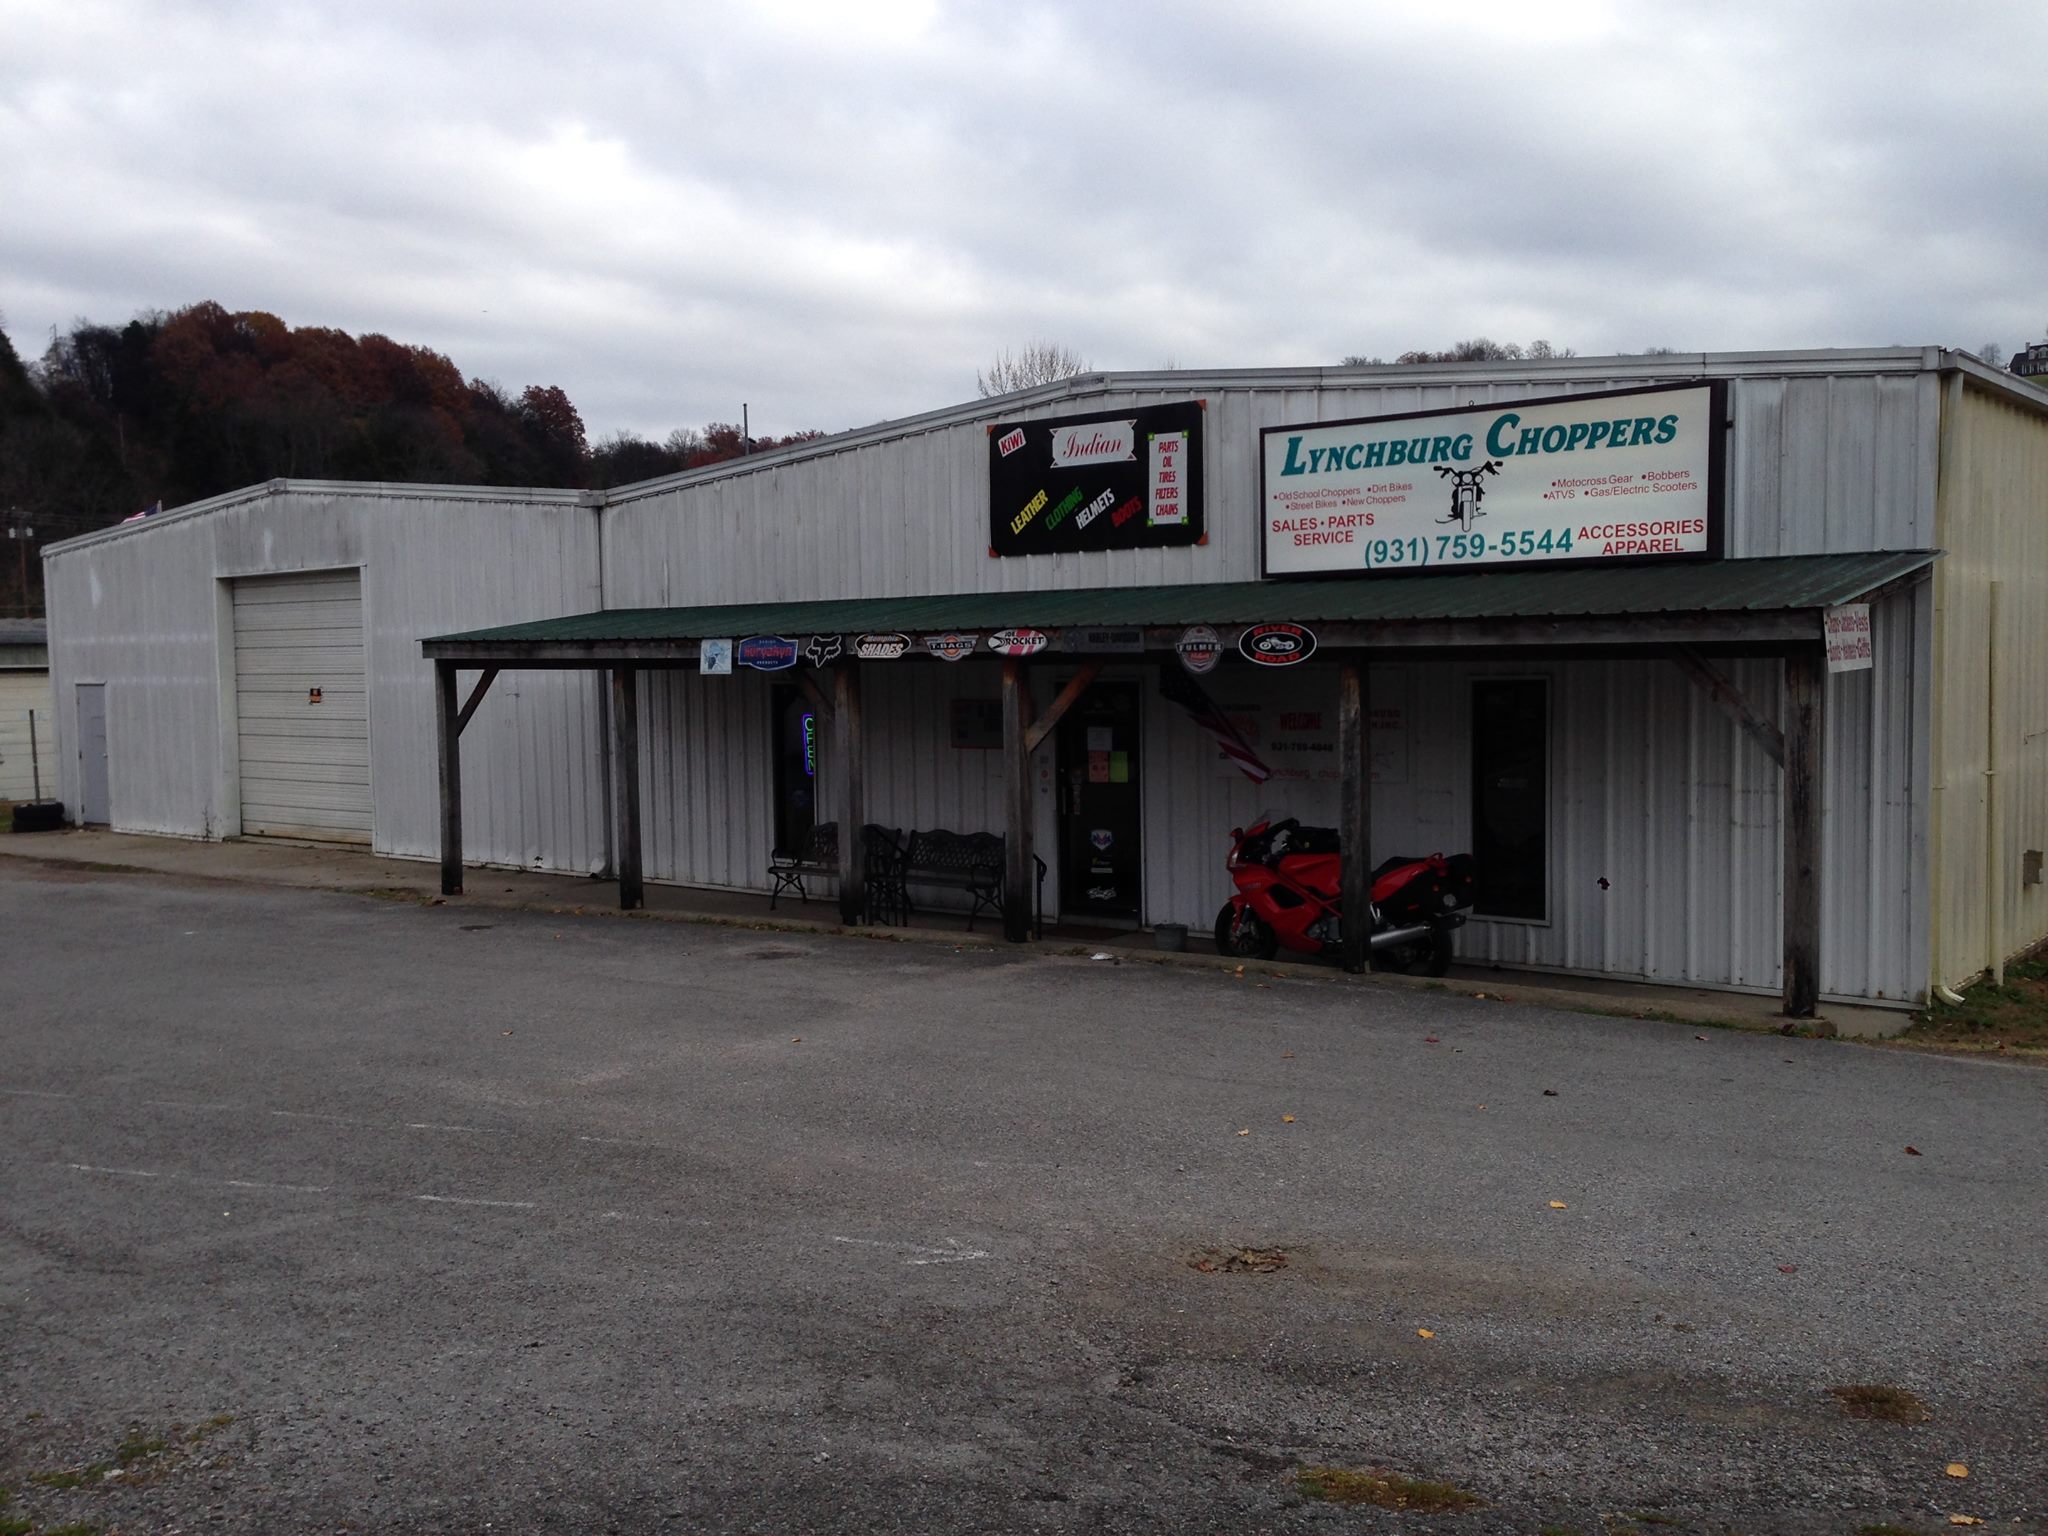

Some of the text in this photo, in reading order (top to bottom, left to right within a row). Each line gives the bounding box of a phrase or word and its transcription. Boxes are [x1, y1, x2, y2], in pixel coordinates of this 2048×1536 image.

[1062, 431, 1122, 458] Indian
[1158, 440, 1179, 453] PARTS
[1280, 413, 1679, 477] LYNCHBURG CHOPPERS
[1162, 456, 1173, 468] OIL
[1158, 471, 1176, 484] TIRES
[1557, 474, 1634, 489] Motocross Gear
[1647, 469, 1691, 481] Bobbers
[1155, 487, 1179, 500] FILTERS
[1278, 486, 1361, 501] Old School Choppers
[1372, 482, 1413, 494] Dirt Bikes
[1590, 480, 1698, 498] Gas/Electric Scooters
[1346, 494, 1406, 507] New Choppers
[1548, 490, 1575, 501] ATVS
[1010, 488, 1049, 535] LEATHER
[1044, 486, 1084, 531] CLOTHING
[1074, 487, 1115, 531] HELMETS
[1110, 495, 1143, 528] BOOTS
[1155, 503, 1179, 516] CHAINS
[1290, 499, 1338, 510] Street Bikes
[1272, 513, 1375, 533] SALES PARTS
[1578, 519, 1704, 541] ACCESSORIES
[1294, 530, 1354, 546] SERVICE
[1365, 528, 1573, 569] (931) 759-5544
[1602, 538, 1685, 555] APPAREL
[1252, 624, 1304, 637] RIVER
[1006, 637, 1044, 645] ROCKET
[1178, 643, 1222, 652] FULMER
[859, 643, 905, 657] SHADES
[1254, 651, 1301, 663] ROAD
